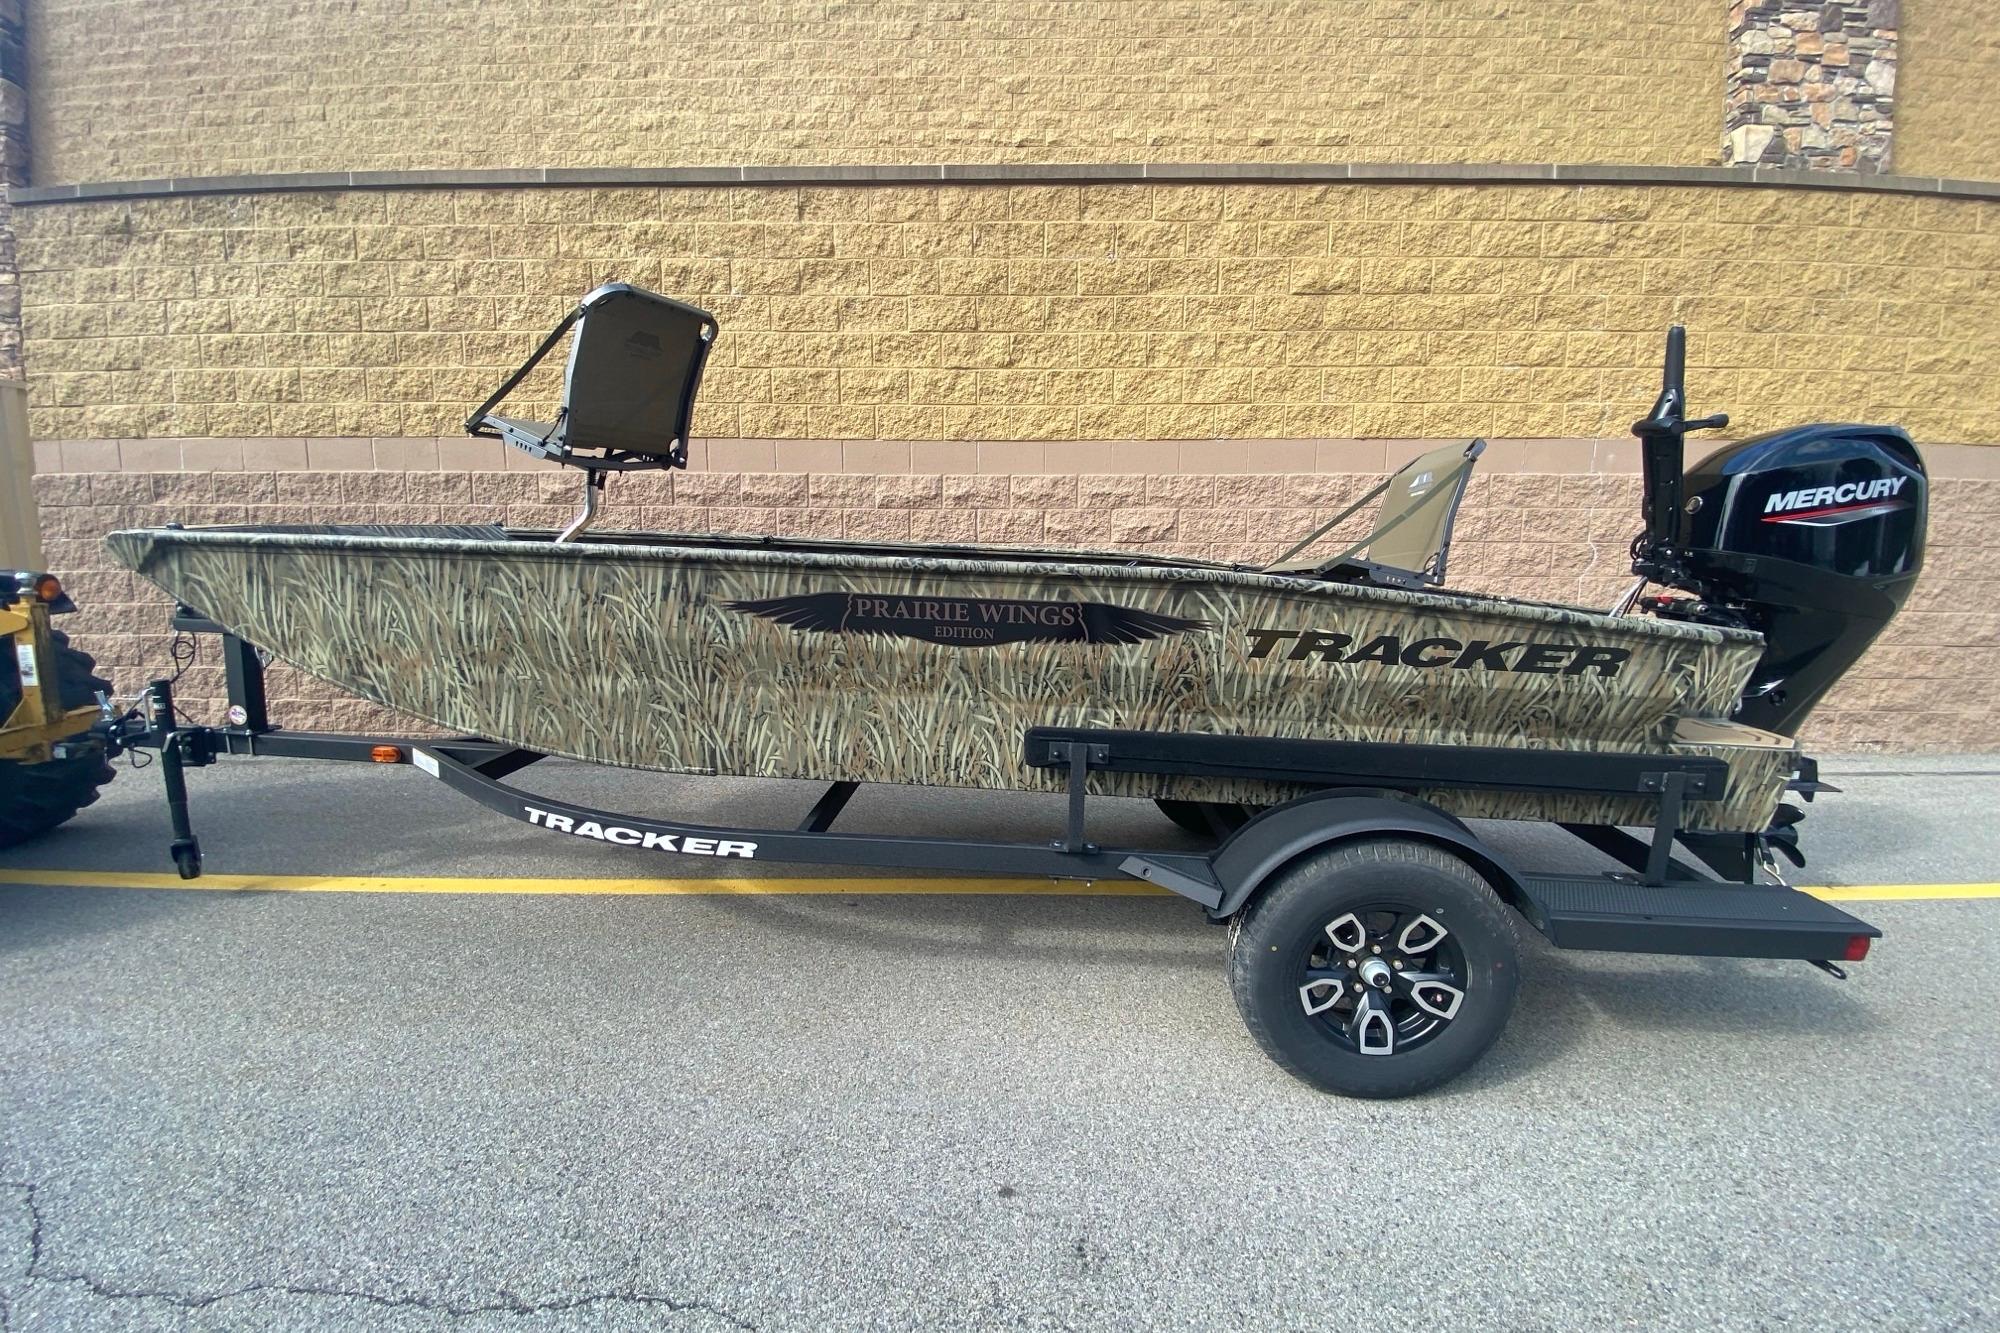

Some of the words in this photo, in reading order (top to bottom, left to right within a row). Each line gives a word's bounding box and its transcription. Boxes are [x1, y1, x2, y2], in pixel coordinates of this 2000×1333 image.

[1764, 476, 1907, 513] MERCURY
[856, 599, 970, 622] PRAIRIE
[977, 603, 1075, 627] WINGS
[934, 625, 995, 640] EDITION
[1246, 628, 1631, 677] TRACKER
[525, 806, 758, 858] TRACKER
